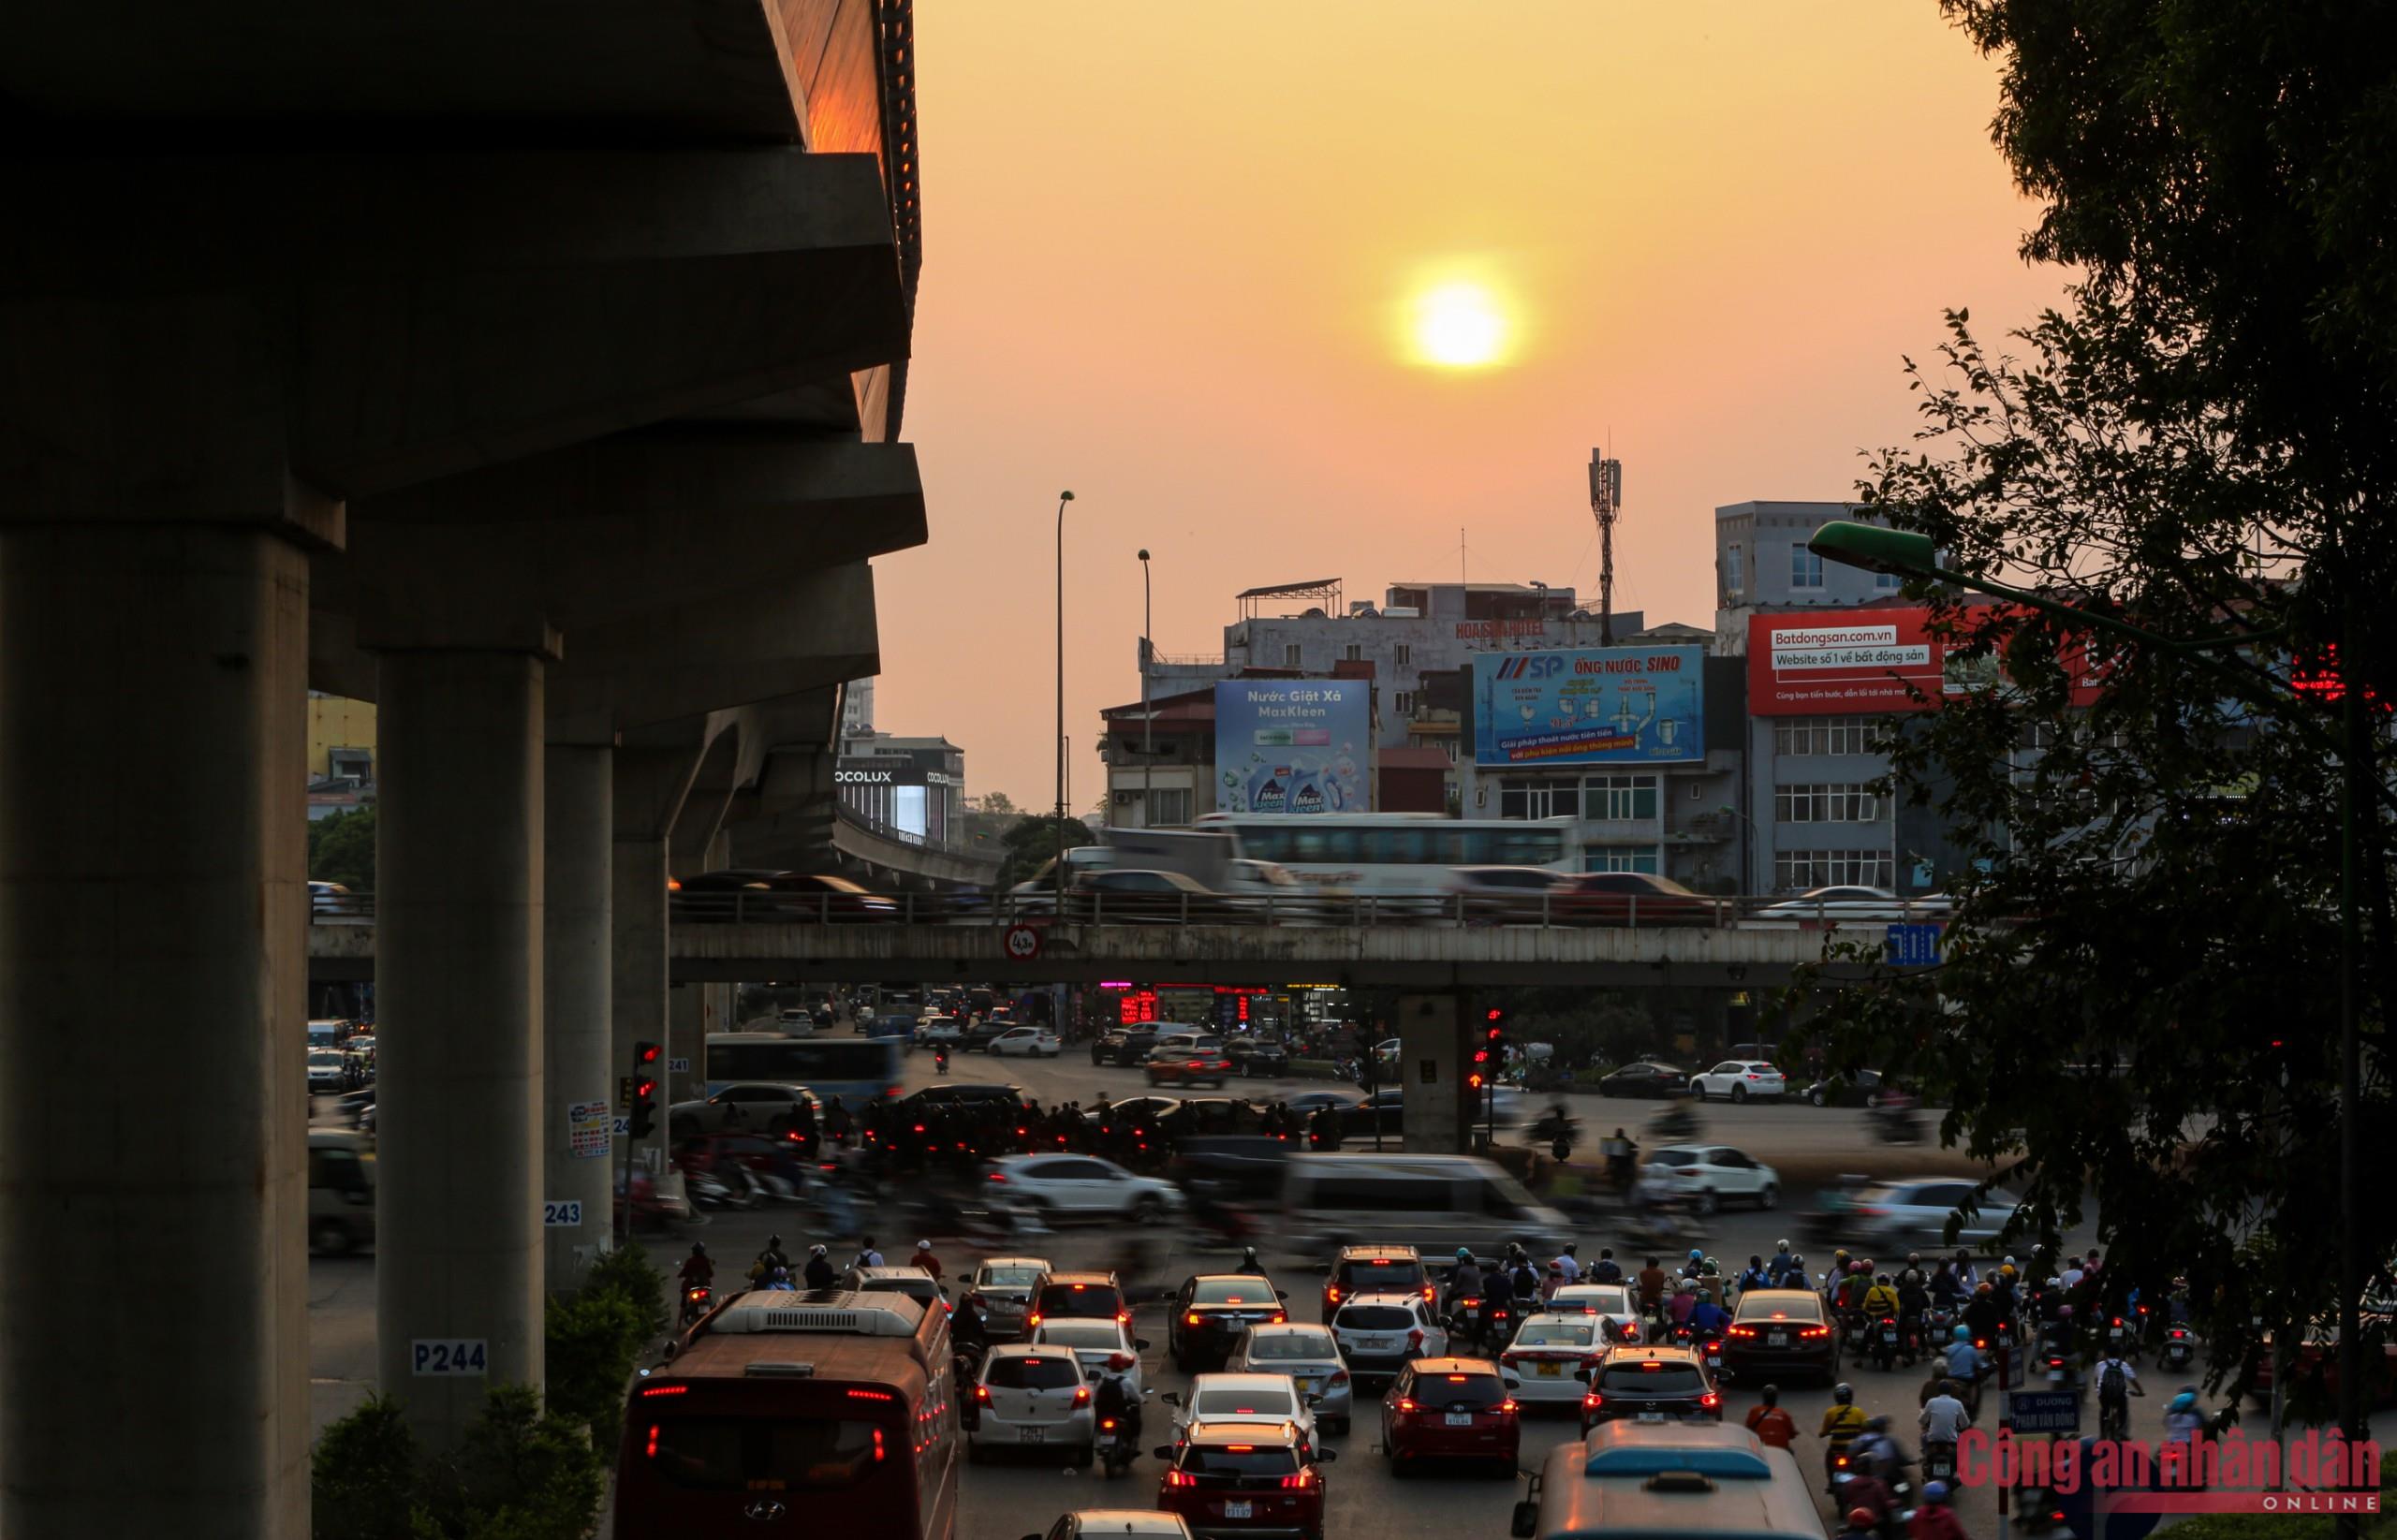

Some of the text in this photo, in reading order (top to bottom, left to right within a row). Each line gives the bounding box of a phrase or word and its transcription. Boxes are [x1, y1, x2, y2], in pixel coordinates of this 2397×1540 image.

[1775, 630, 1891, 647] Batdongsan.com.vn
[1776, 648, 1924, 666] Website số 1 về bất động sản
[1574, 655, 1681, 675] ỐNG NƯỚC SINO
[1247, 689, 1342, 705] Nước Giặt Xả
[1775, 690, 1795, 701] Cùng
[1795, 690, 1809, 700] bạn
[1879, 687, 1893, 697] nhà
[1258, 705, 1326, 718] MaxKleen
[927, 771, 949, 785] COCOLUX
[1260, 791, 1286, 802] Max
[1297, 795, 1322, 806] Max
[669, 1060, 687, 1071] 241
[545, 1204, 580, 1224] 243
[416, 1343, 485, 1371] P244
